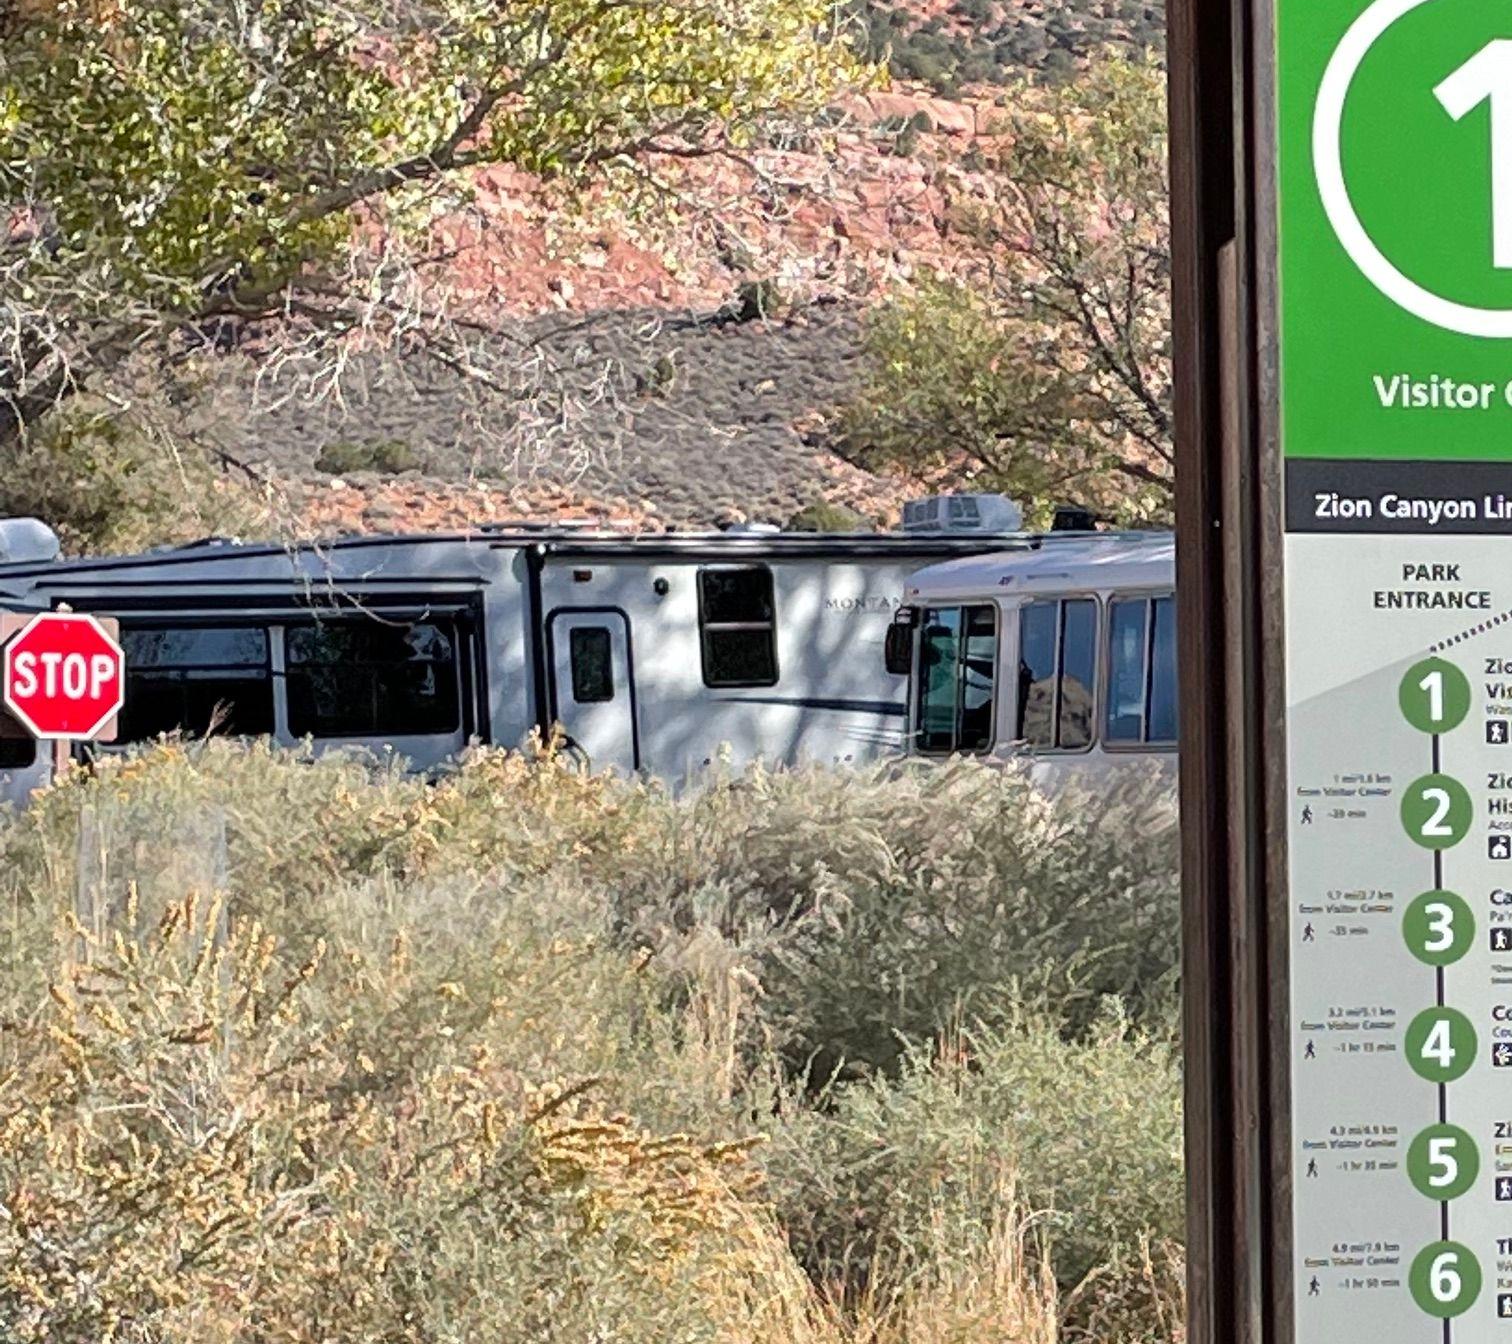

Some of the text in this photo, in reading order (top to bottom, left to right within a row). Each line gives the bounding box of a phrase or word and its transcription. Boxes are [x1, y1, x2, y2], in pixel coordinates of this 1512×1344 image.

[1373, 374, 1494, 408] Visitor
[1315, 493, 1371, 517] Zion
[1380, 495, 1475, 524] Canyon
[1403, 564, 1459, 580] PARK
[1374, 591, 1490, 608] ENTRANCE
[14, 651, 115, 700] STOP
[1419, 670, 1443, 721] 1
[1421, 787, 1453, 836] 2
[1425, 902, 1454, 952] 3
[1421, 1019, 1456, 1067] 4
[1429, 1136, 1458, 1187] 5
[1430, 1251, 1461, 1302] 6
